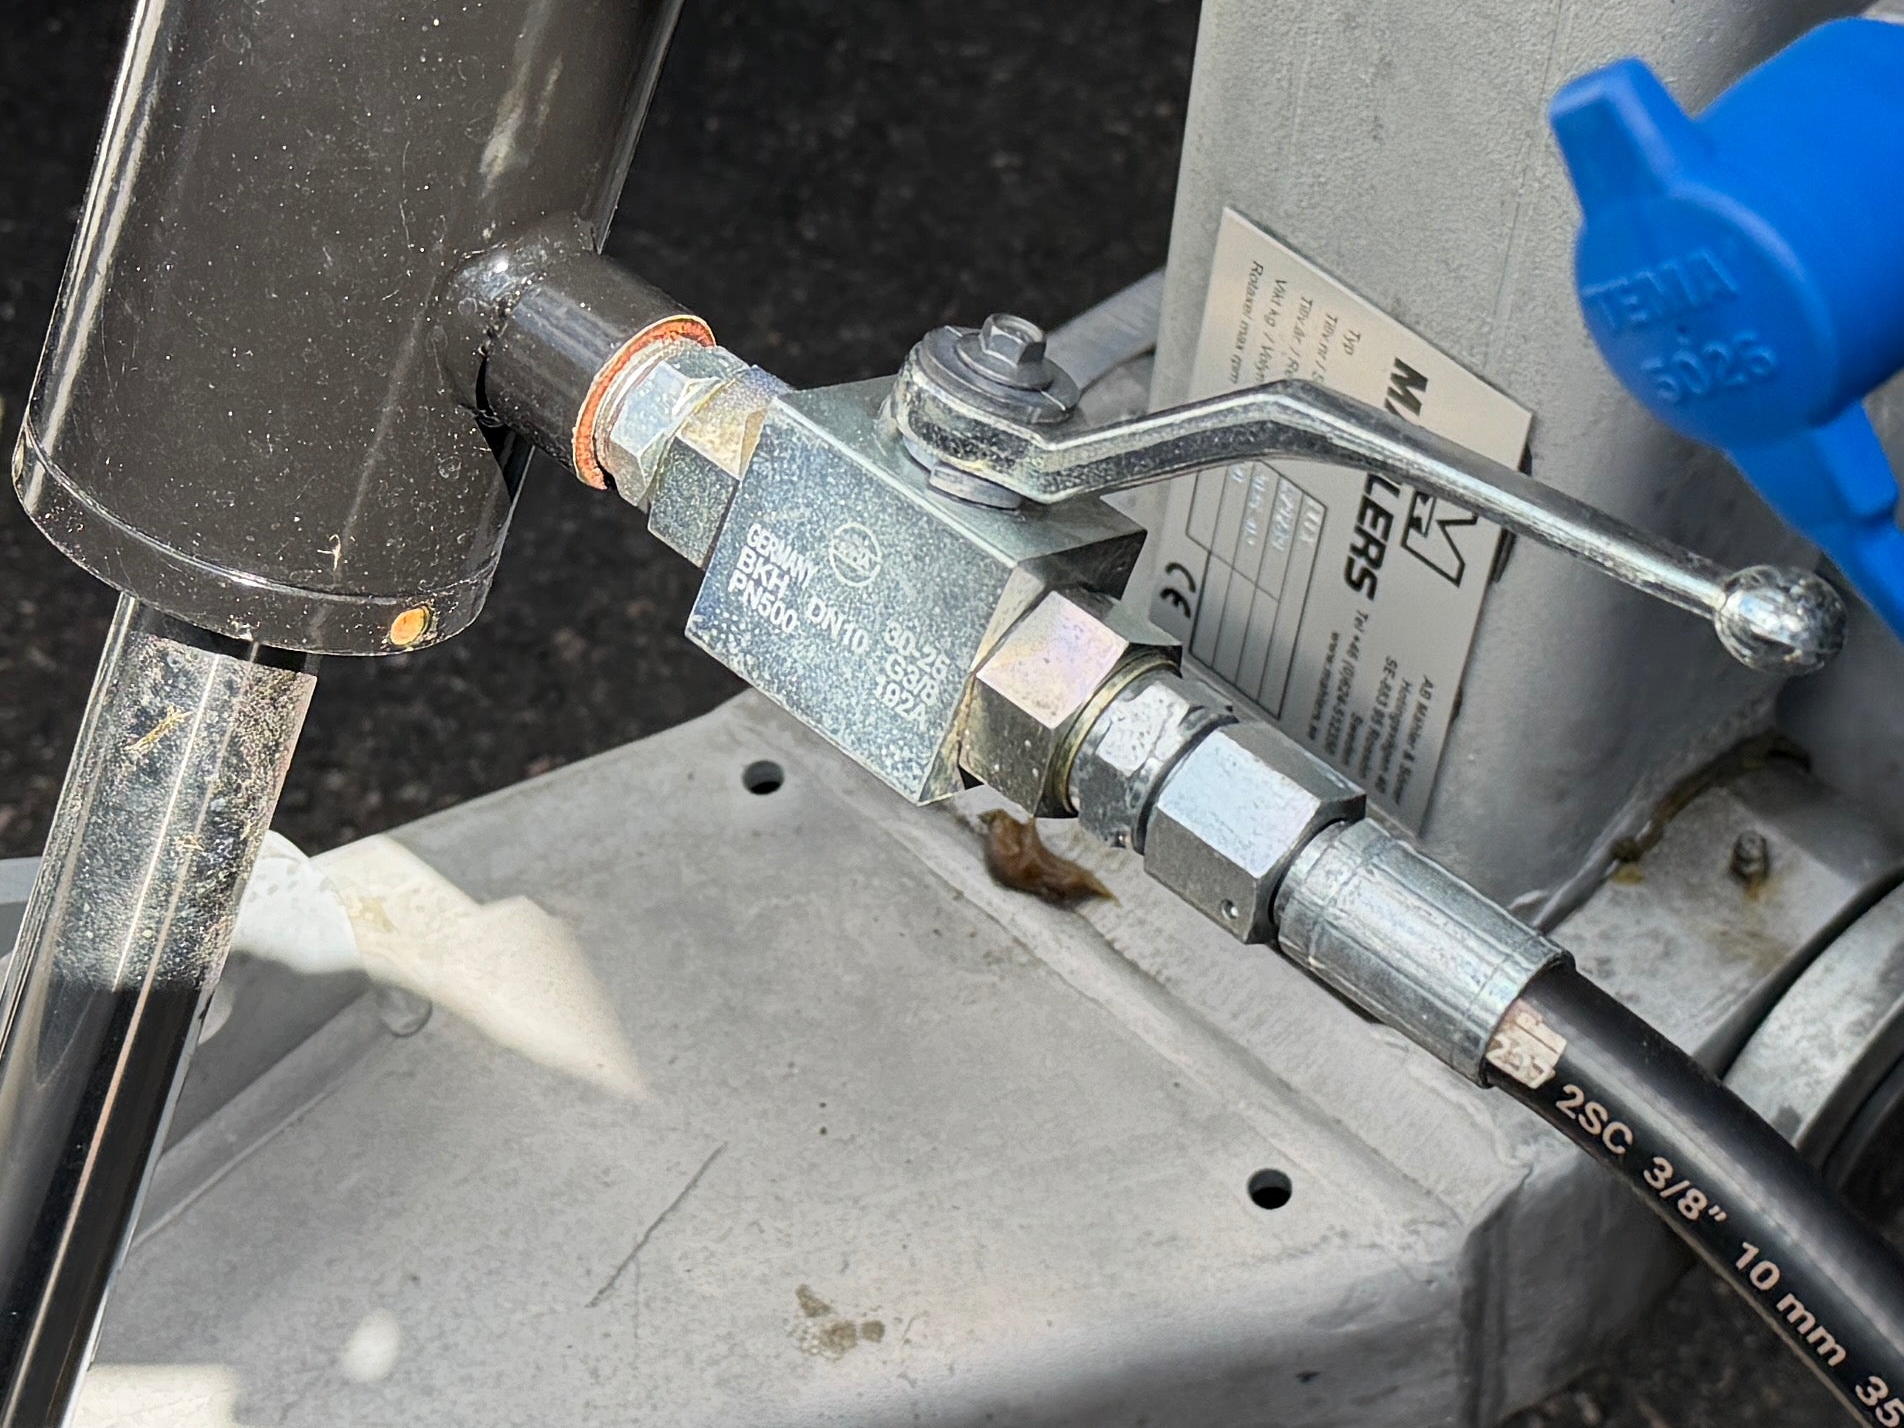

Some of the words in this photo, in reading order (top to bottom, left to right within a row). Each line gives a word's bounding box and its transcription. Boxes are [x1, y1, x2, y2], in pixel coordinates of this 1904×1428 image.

[1581, 248, 1740, 329] TEMA
[1342, 329, 1361, 356] Typ
[1344, 356, 1429, 601] MLERS
[746, 523, 819, 590] GERMANY
[728, 573, 797, 634] PN500
[736, 546, 789, 599] BKH
[805, 596, 868, 654] DN10
[886, 654, 940, 706] G3/8
[1555, 1083, 1634, 1155] 2SC
[1735, 1241, 1781, 1291] 10
[1775, 1292, 1847, 1368] mm
